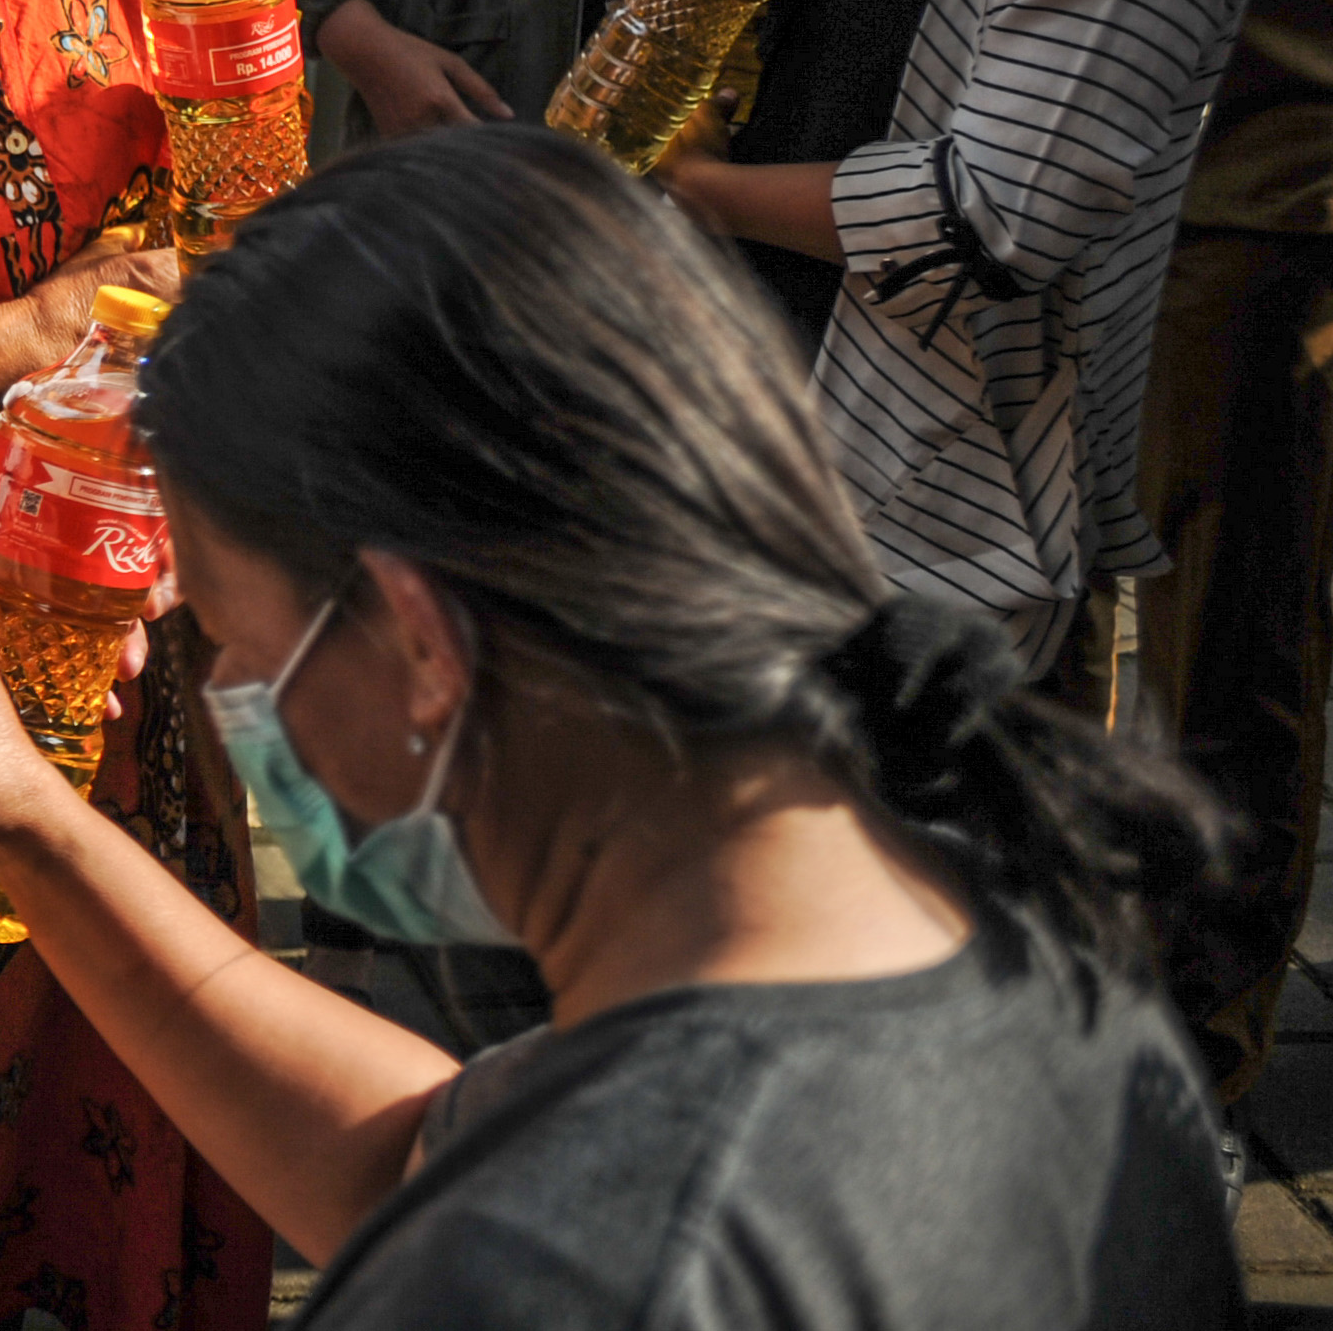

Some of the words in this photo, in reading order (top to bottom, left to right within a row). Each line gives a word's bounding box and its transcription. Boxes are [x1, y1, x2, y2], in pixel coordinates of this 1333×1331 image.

[236, 62, 258, 77] Rp.
[259, 45, 294, 70] 14.000
[81, 519, 170, 574] Rizki
